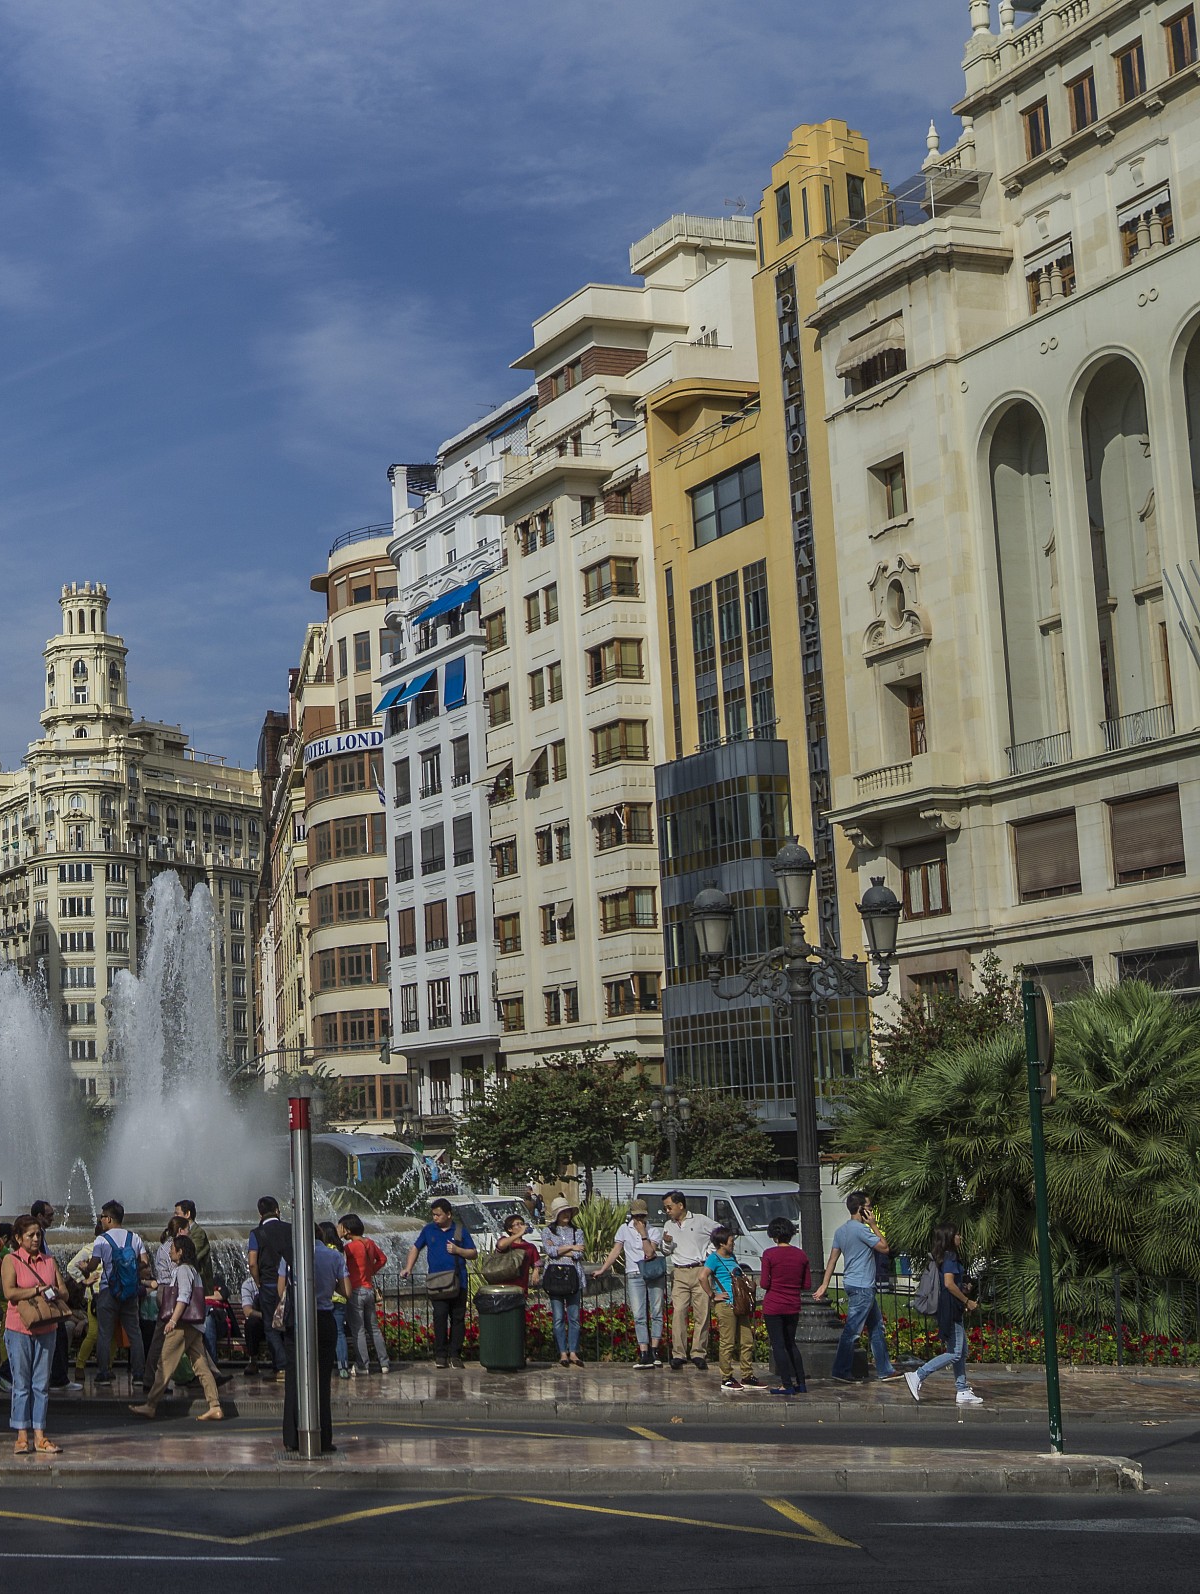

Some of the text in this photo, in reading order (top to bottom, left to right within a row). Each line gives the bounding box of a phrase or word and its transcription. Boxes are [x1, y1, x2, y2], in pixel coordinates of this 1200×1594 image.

[777, 293, 802, 455] RIALTO
[791, 487, 818, 656] TEATRE
[336, 731, 383, 751] LOND
